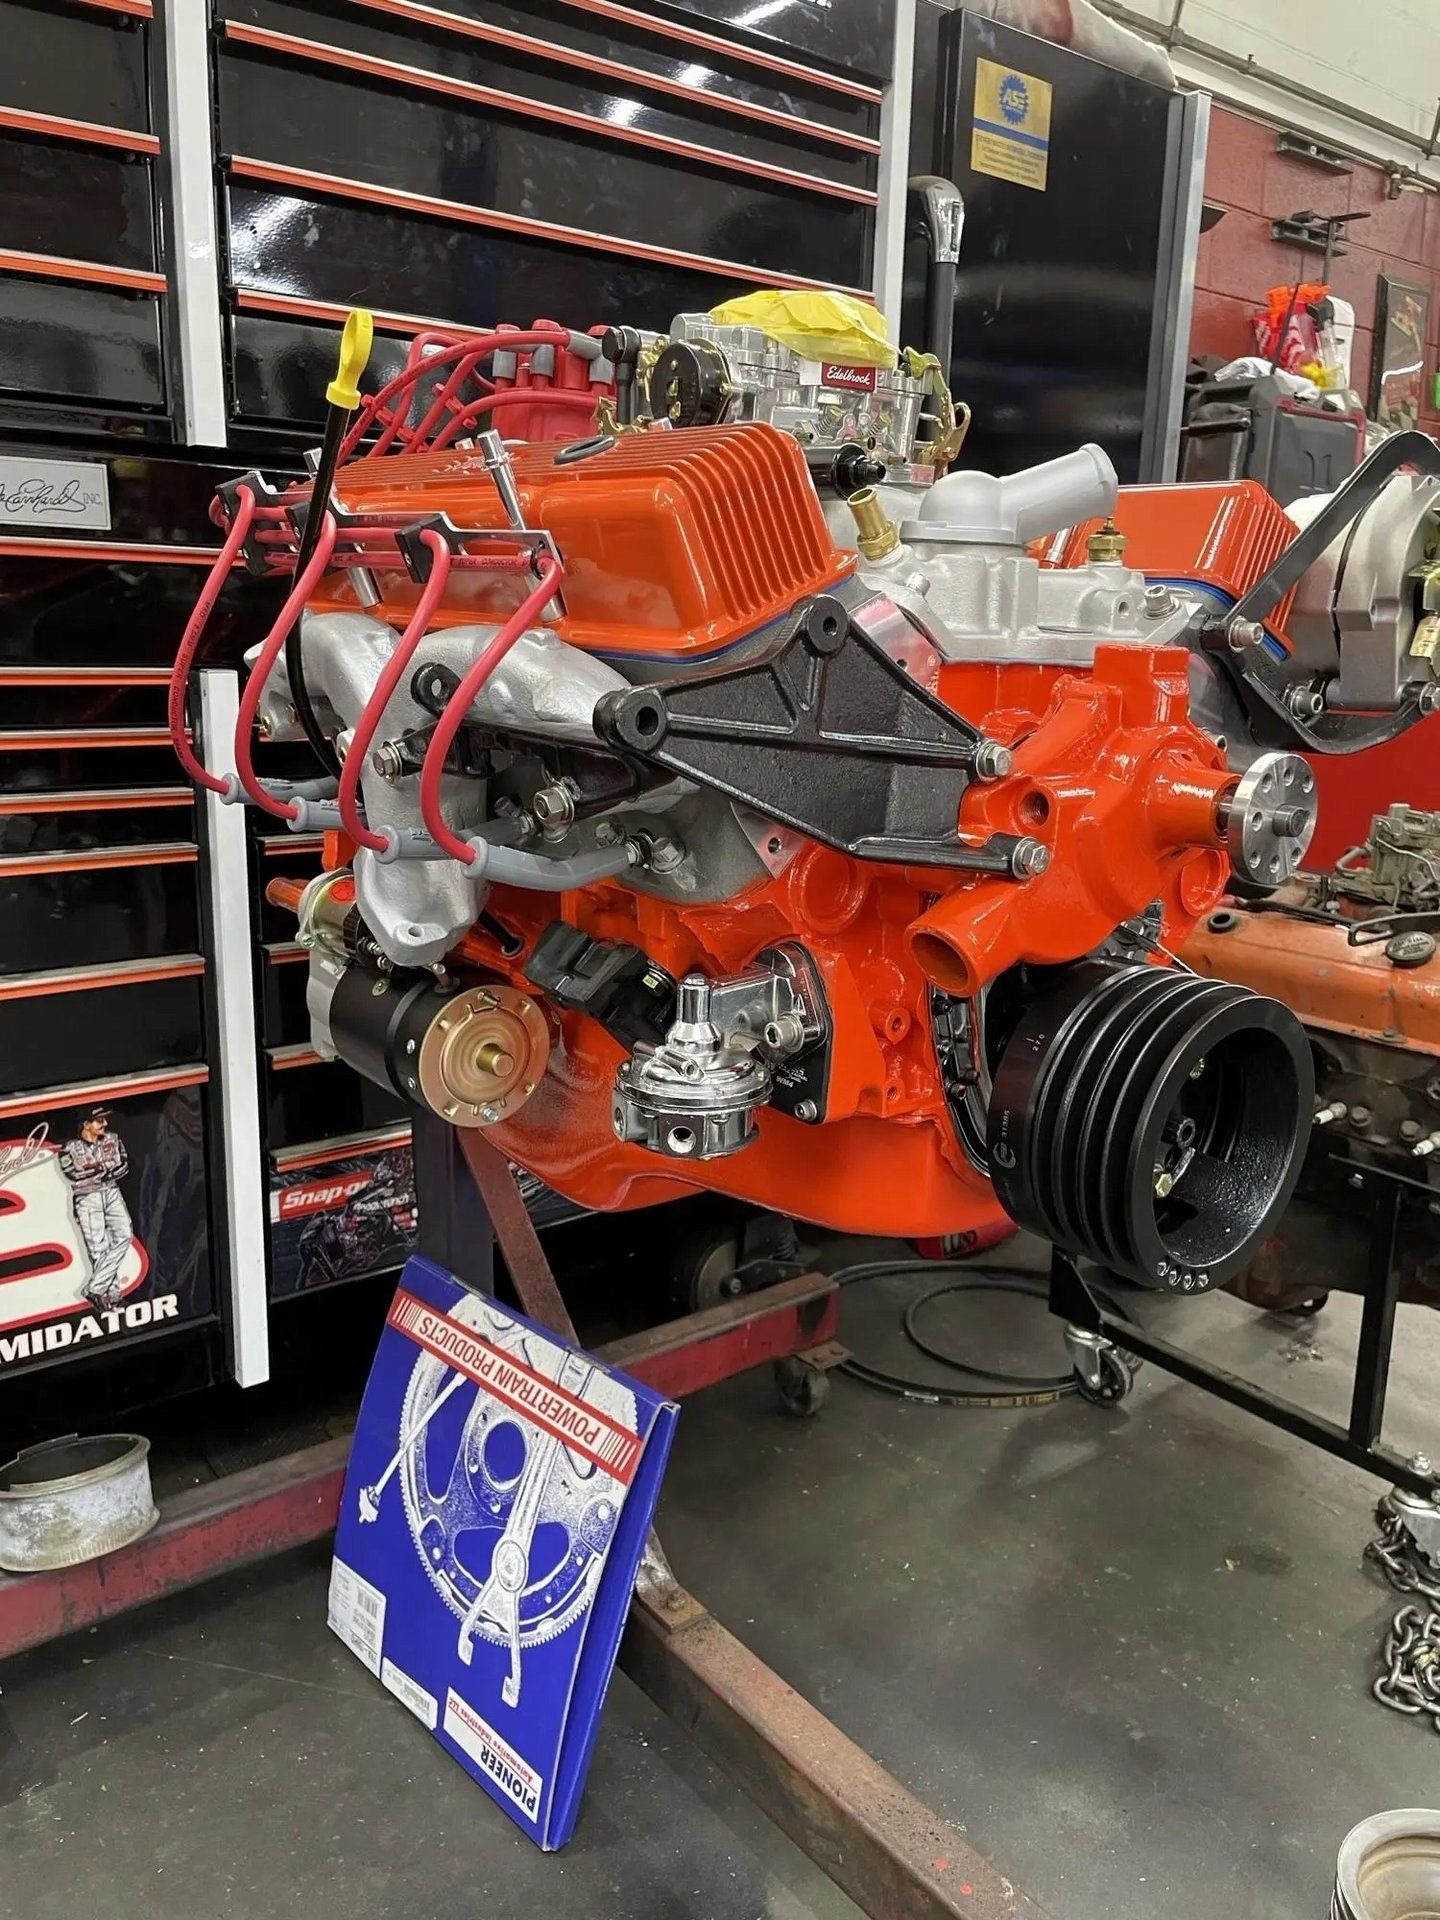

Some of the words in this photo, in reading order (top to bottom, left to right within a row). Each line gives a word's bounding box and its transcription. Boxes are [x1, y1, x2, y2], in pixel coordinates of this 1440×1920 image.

[826, 365, 871, 386] Edelbrock
[418, 1316, 494, 1382] PRODUCTS
[492, 1366, 601, 1446] POWERTRAIN
[460, 1708, 492, 1744] Industries
[480, 1744, 536, 1813] PIONEER
[493, 1739, 533, 1783] Automotive
